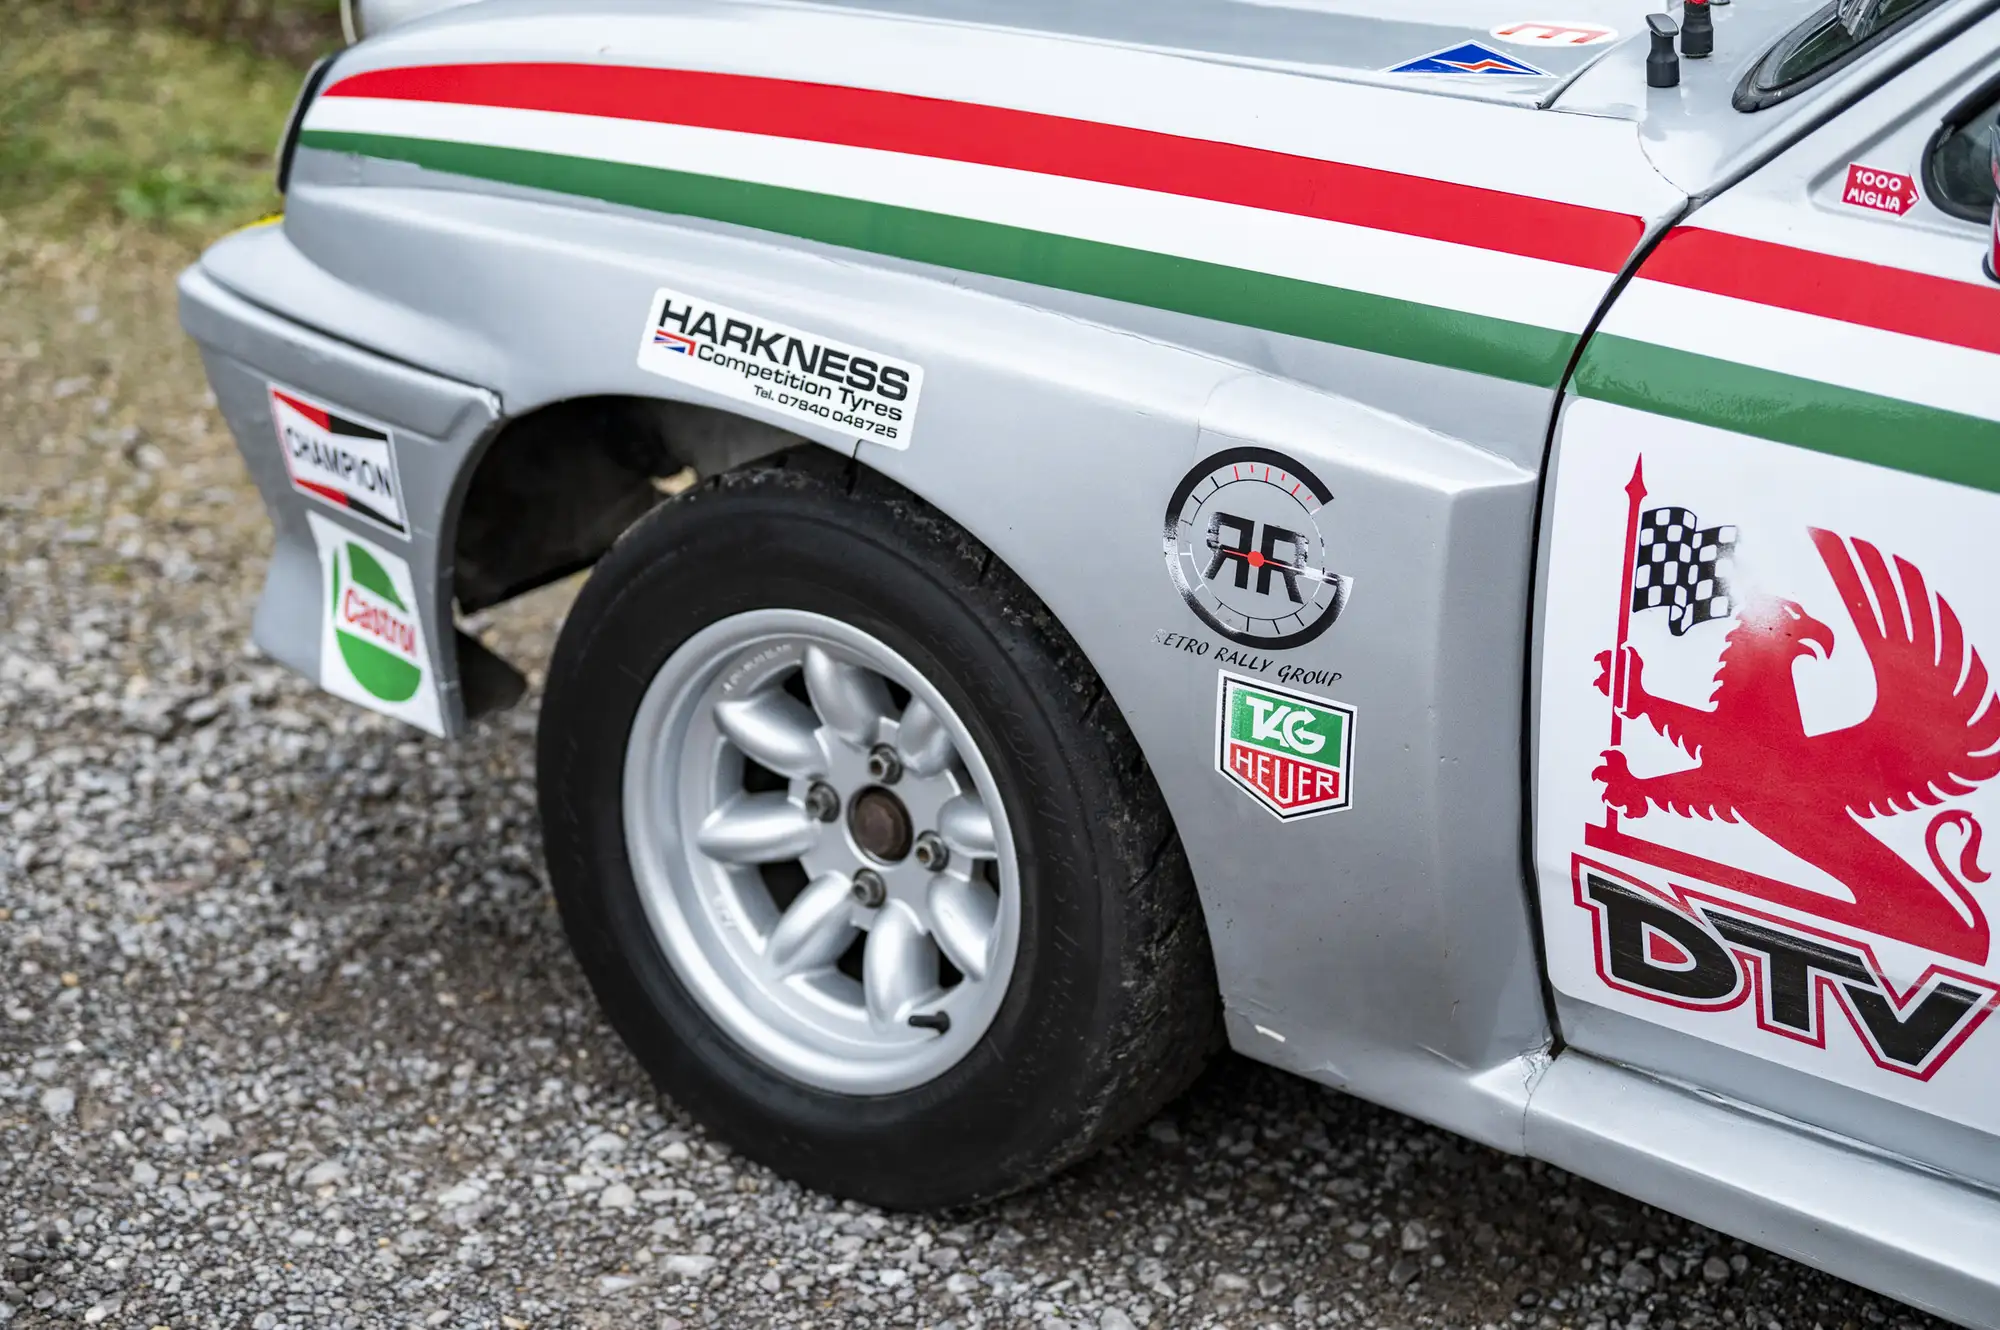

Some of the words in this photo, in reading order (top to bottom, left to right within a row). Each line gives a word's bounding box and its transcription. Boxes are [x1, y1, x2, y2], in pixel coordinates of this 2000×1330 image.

[1846, 187, 1901, 212] MIGLIA
[1856, 170, 1902, 192] 1000
[658, 299, 910, 402] HARKNESS
[697, 344, 833, 400] Competition
[838, 386, 903, 421] Tyres
[754, 384, 775, 402] Tel.
[778, 392, 830, 418] 07840
[832, 410, 898, 439] 048725
[286, 425, 393, 499] CHAMPION
[344, 588, 417, 657] Castrol
[1214, 647, 1274, 673] RALLY
[1277, 664, 1342, 687] GROUP
[1246, 695, 1326, 755] TAG
[1235, 748, 1335, 805] HEUER
[1586, 872, 1984, 1067] DTV
